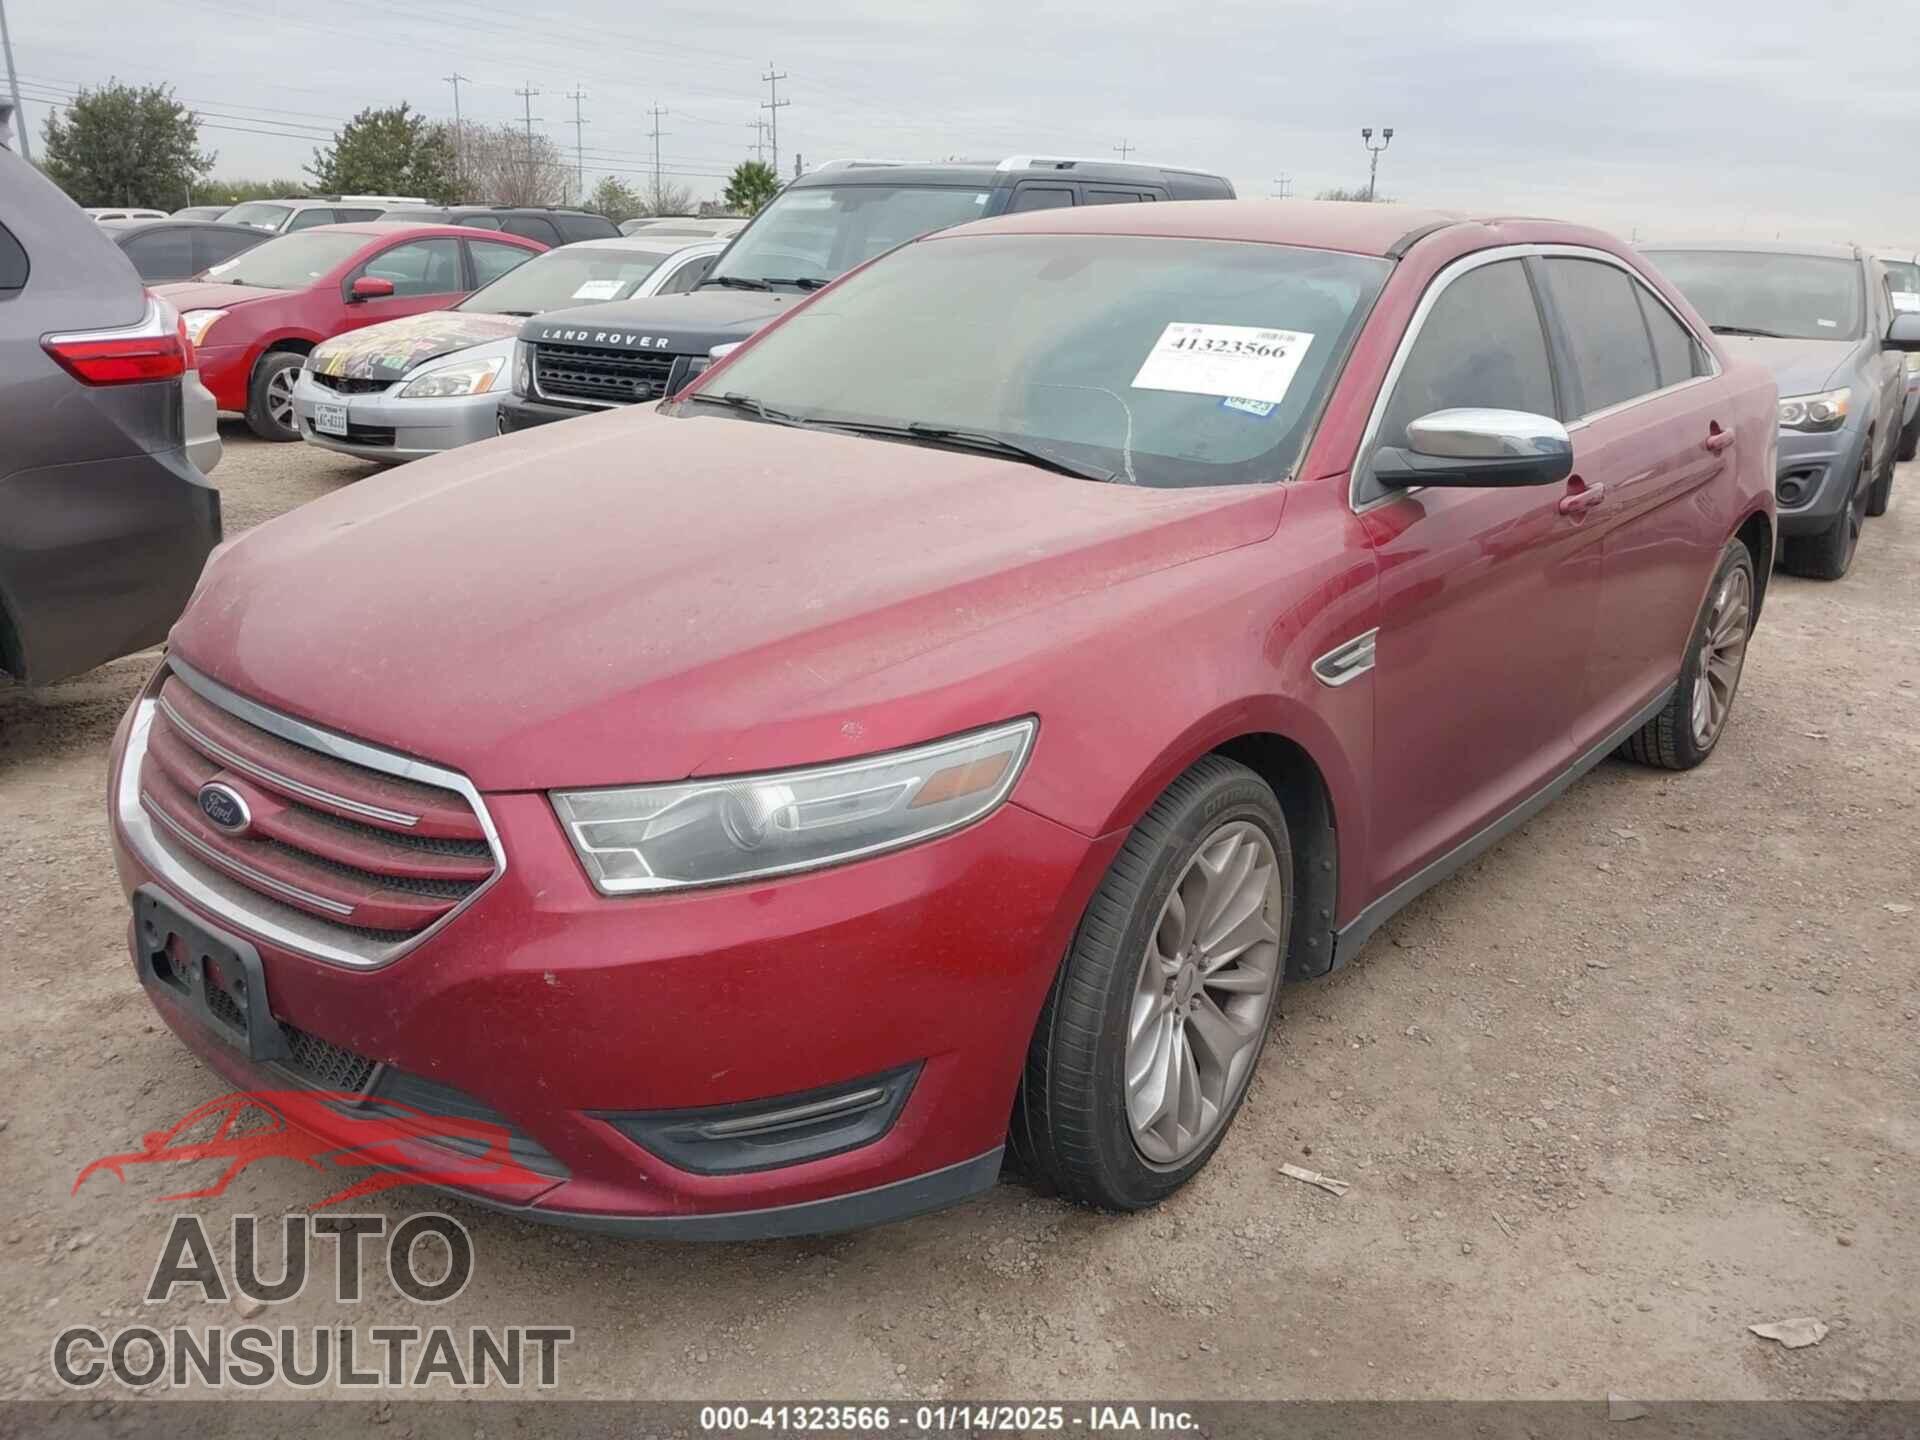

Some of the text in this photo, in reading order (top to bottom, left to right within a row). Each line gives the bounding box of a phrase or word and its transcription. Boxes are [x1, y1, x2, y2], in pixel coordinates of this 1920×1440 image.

[542, 329, 669, 349] LAND ROVER
[1170, 336, 1287, 359] 41323566
[205, 791, 235, 823] Ford
